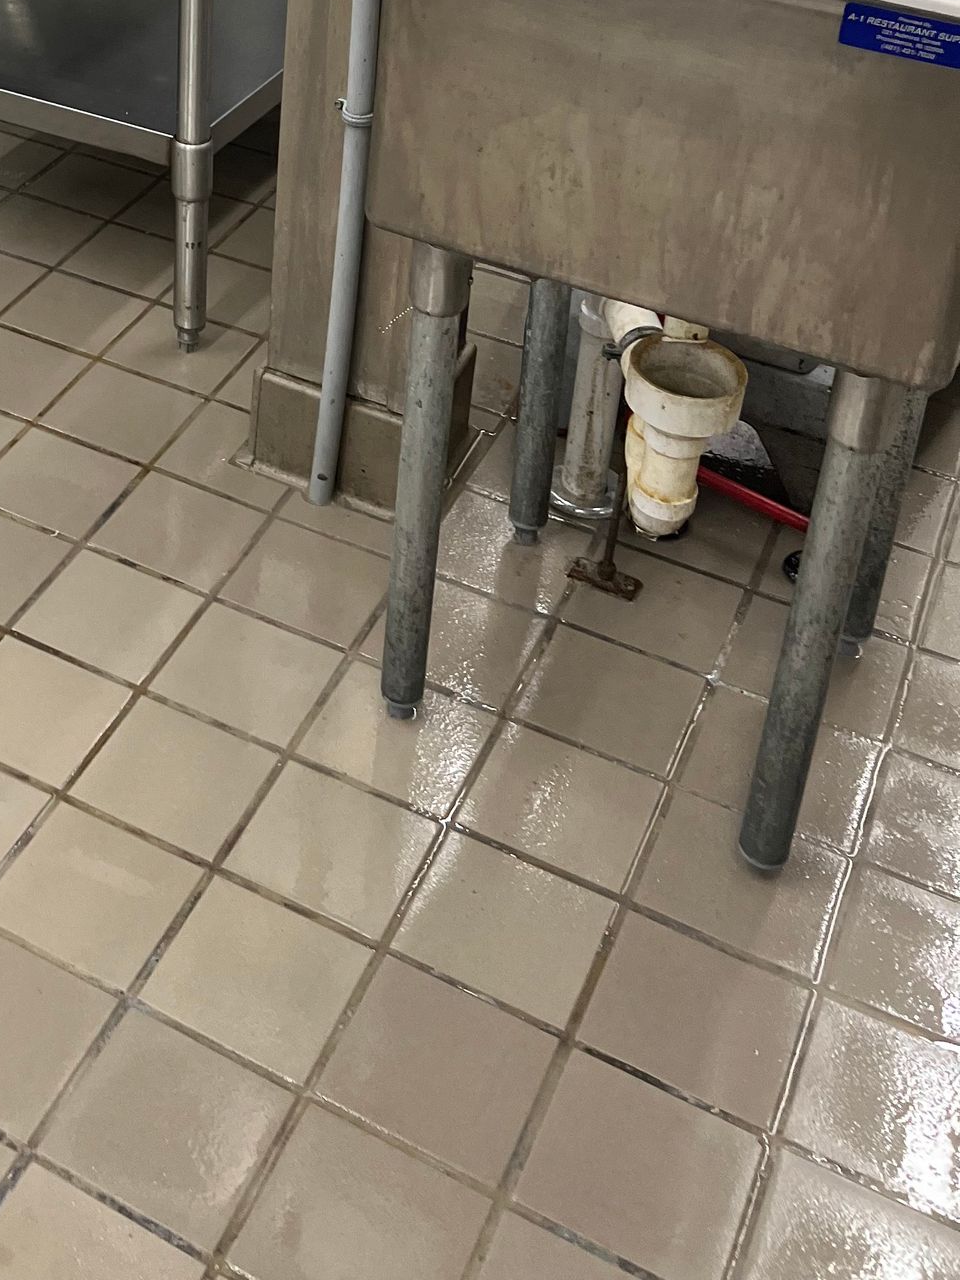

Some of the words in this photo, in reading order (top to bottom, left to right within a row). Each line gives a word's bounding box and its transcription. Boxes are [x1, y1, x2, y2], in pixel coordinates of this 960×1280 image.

[847, 12, 865, 23] A-1
[866, 16, 937, 38] RESTAURANT
[938, 32, 960, 44] SUP
